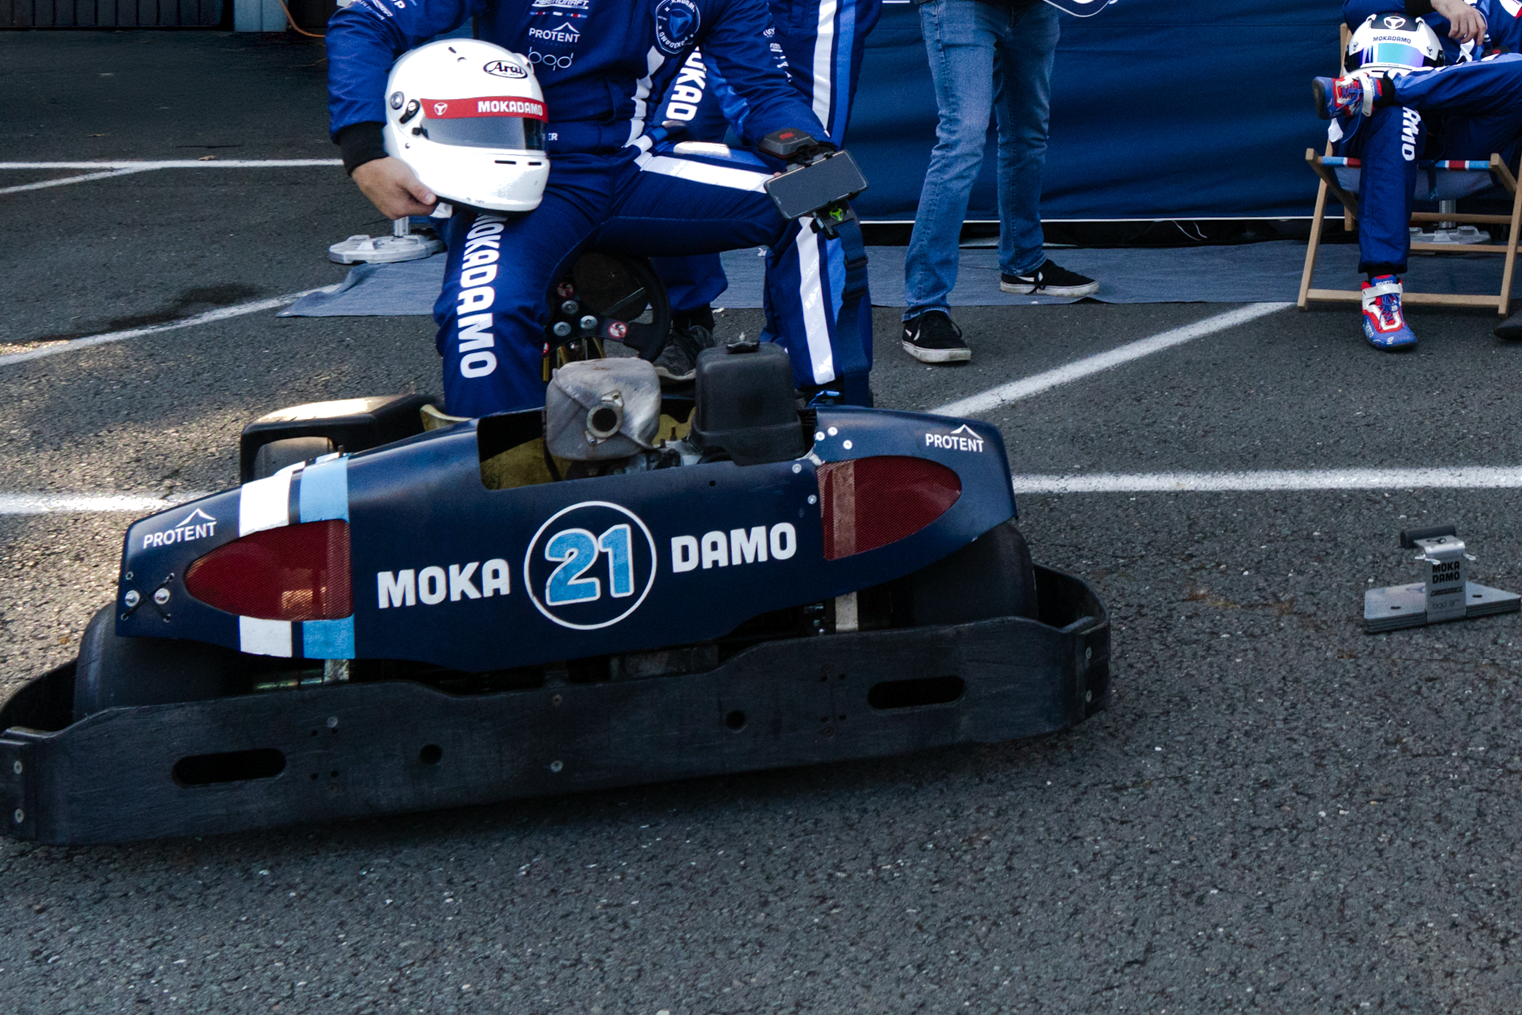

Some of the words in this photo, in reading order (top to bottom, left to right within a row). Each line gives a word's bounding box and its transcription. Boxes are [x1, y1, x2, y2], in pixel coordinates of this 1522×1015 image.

[529, 27, 581, 44] PROTENT
[1373, 35, 1411, 44] MOKADAMO
[487, 61, 524, 74] Arai
[477, 100, 543, 116] MOKADAMO
[925, 432, 984, 454] PROTENT
[143, 521, 216, 550] PROTENT
[377, 558, 511, 609] MOKA
[545, 523, 635, 606] 21
[671, 522, 797, 574] DAMO
[1432, 561, 1460, 574] MOKA
[1432, 571, 1460, 584] DAMO
